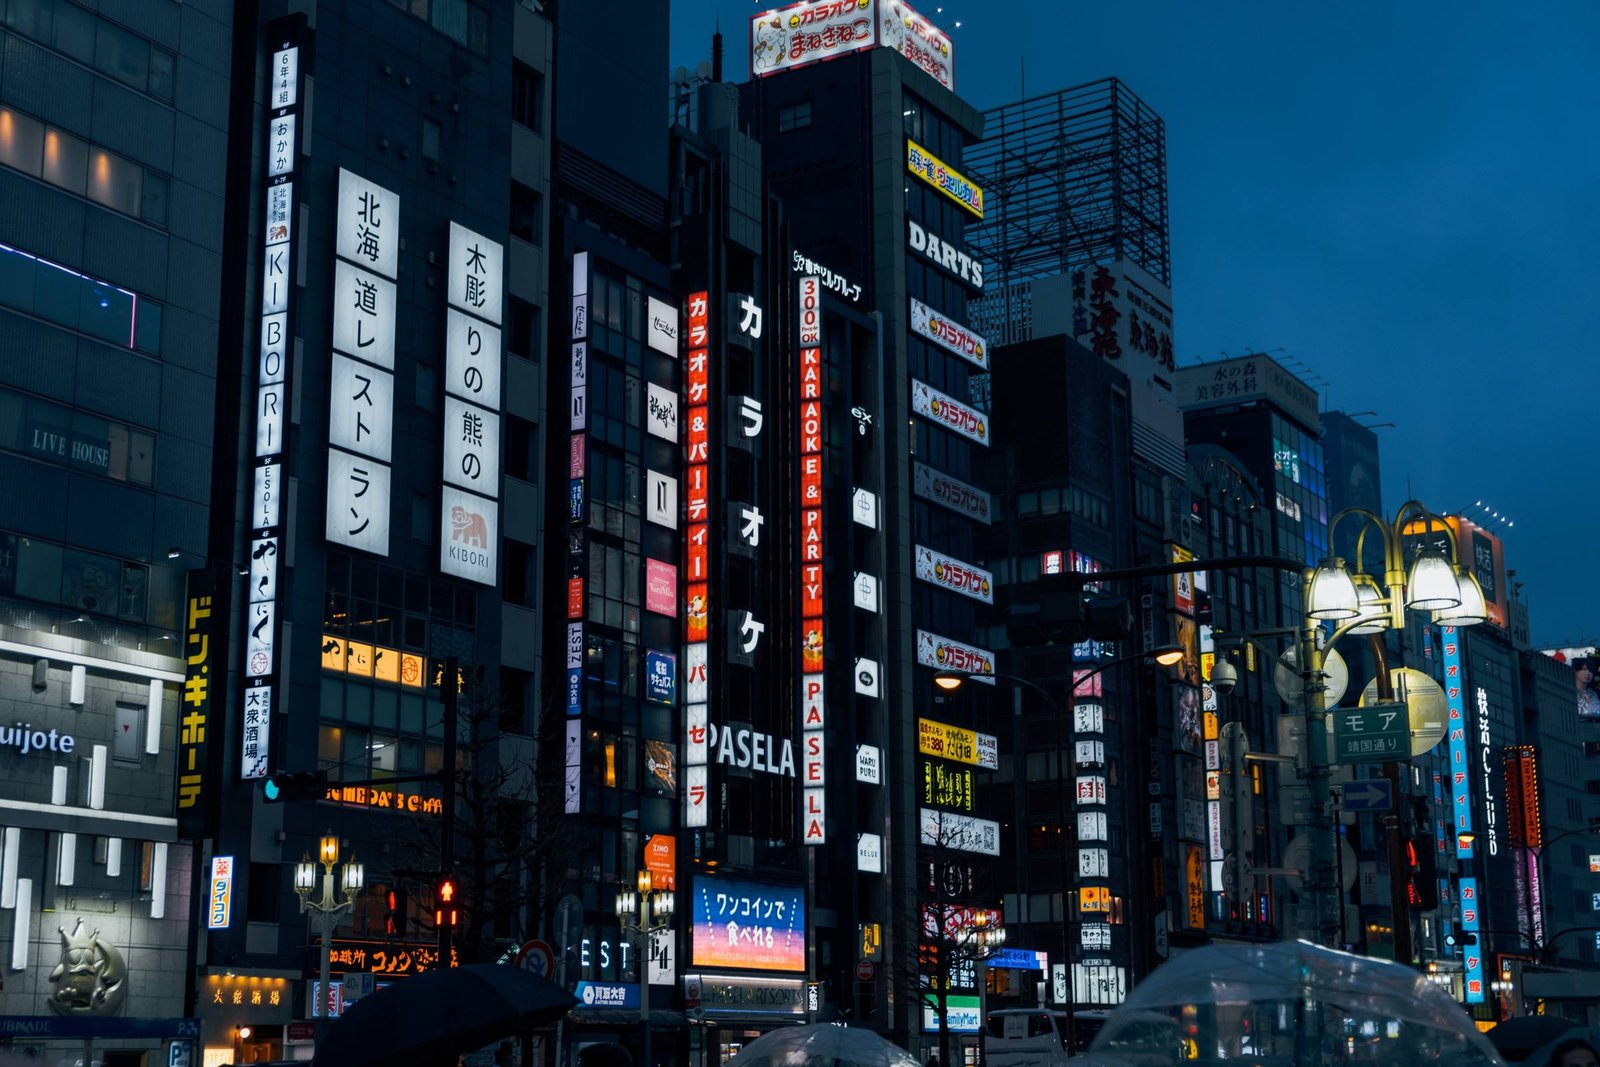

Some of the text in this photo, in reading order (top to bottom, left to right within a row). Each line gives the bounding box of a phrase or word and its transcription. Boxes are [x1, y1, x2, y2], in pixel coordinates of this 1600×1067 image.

[789, 19, 870, 60] まねきねこ
[278, 53, 290, 104] 6年4組
[275, 122, 288, 171] おかか
[279, 188, 288, 223] 北海道
[909, 220, 983, 288] DARTS
[804, 280, 816, 326] 300
[263, 252, 284, 450] KIBORI
[802, 334, 819, 345] OK
[937, 319, 976, 356] カラオケ
[349, 190, 382, 536] 北海道レストラン
[461, 243, 487, 480] 木彫りの熊の
[1214, 362, 1257, 381] 水の森
[1195, 378, 1257, 401] 美容外科
[939, 399, 978, 434] カラオケ
[33, 429, 110, 469] LIVE HOUSE
[689, 297, 708, 577] カラオケ&パーティー
[739, 295, 766, 655] カラオケ
[804, 349, 820, 601] KARAOKE & PARTY
[262, 467, 272, 527] ESOLA
[263, 531, 271, 539] 4F
[449, 546, 489, 570] KIBORI
[943, 563, 983, 594] カラオケ
[572, 627, 582, 664] ZEST
[179, 595, 213, 811] ドン・キホーテ
[1345, 711, 1398, 732] モア
[244, 690, 261, 760] 大衆酒場
[689, 665, 707, 807] パセラ
[806, 683, 823, 838] PASELA
[1347, 738, 1398, 753] 靖国通り
[653, 844, 669, 854] ZINO
[215, 859, 230, 877] 薬
[716, 893, 786, 920] ワンコインで
[727, 920, 775, 948] 食べれる
[1463, 888, 1481, 994] カラケ館
[212, 987, 282, 1007] 大衆酒場
[595, 986, 626, 1001] 買取大吉
[947, 1012, 978, 1027] amilyMart
